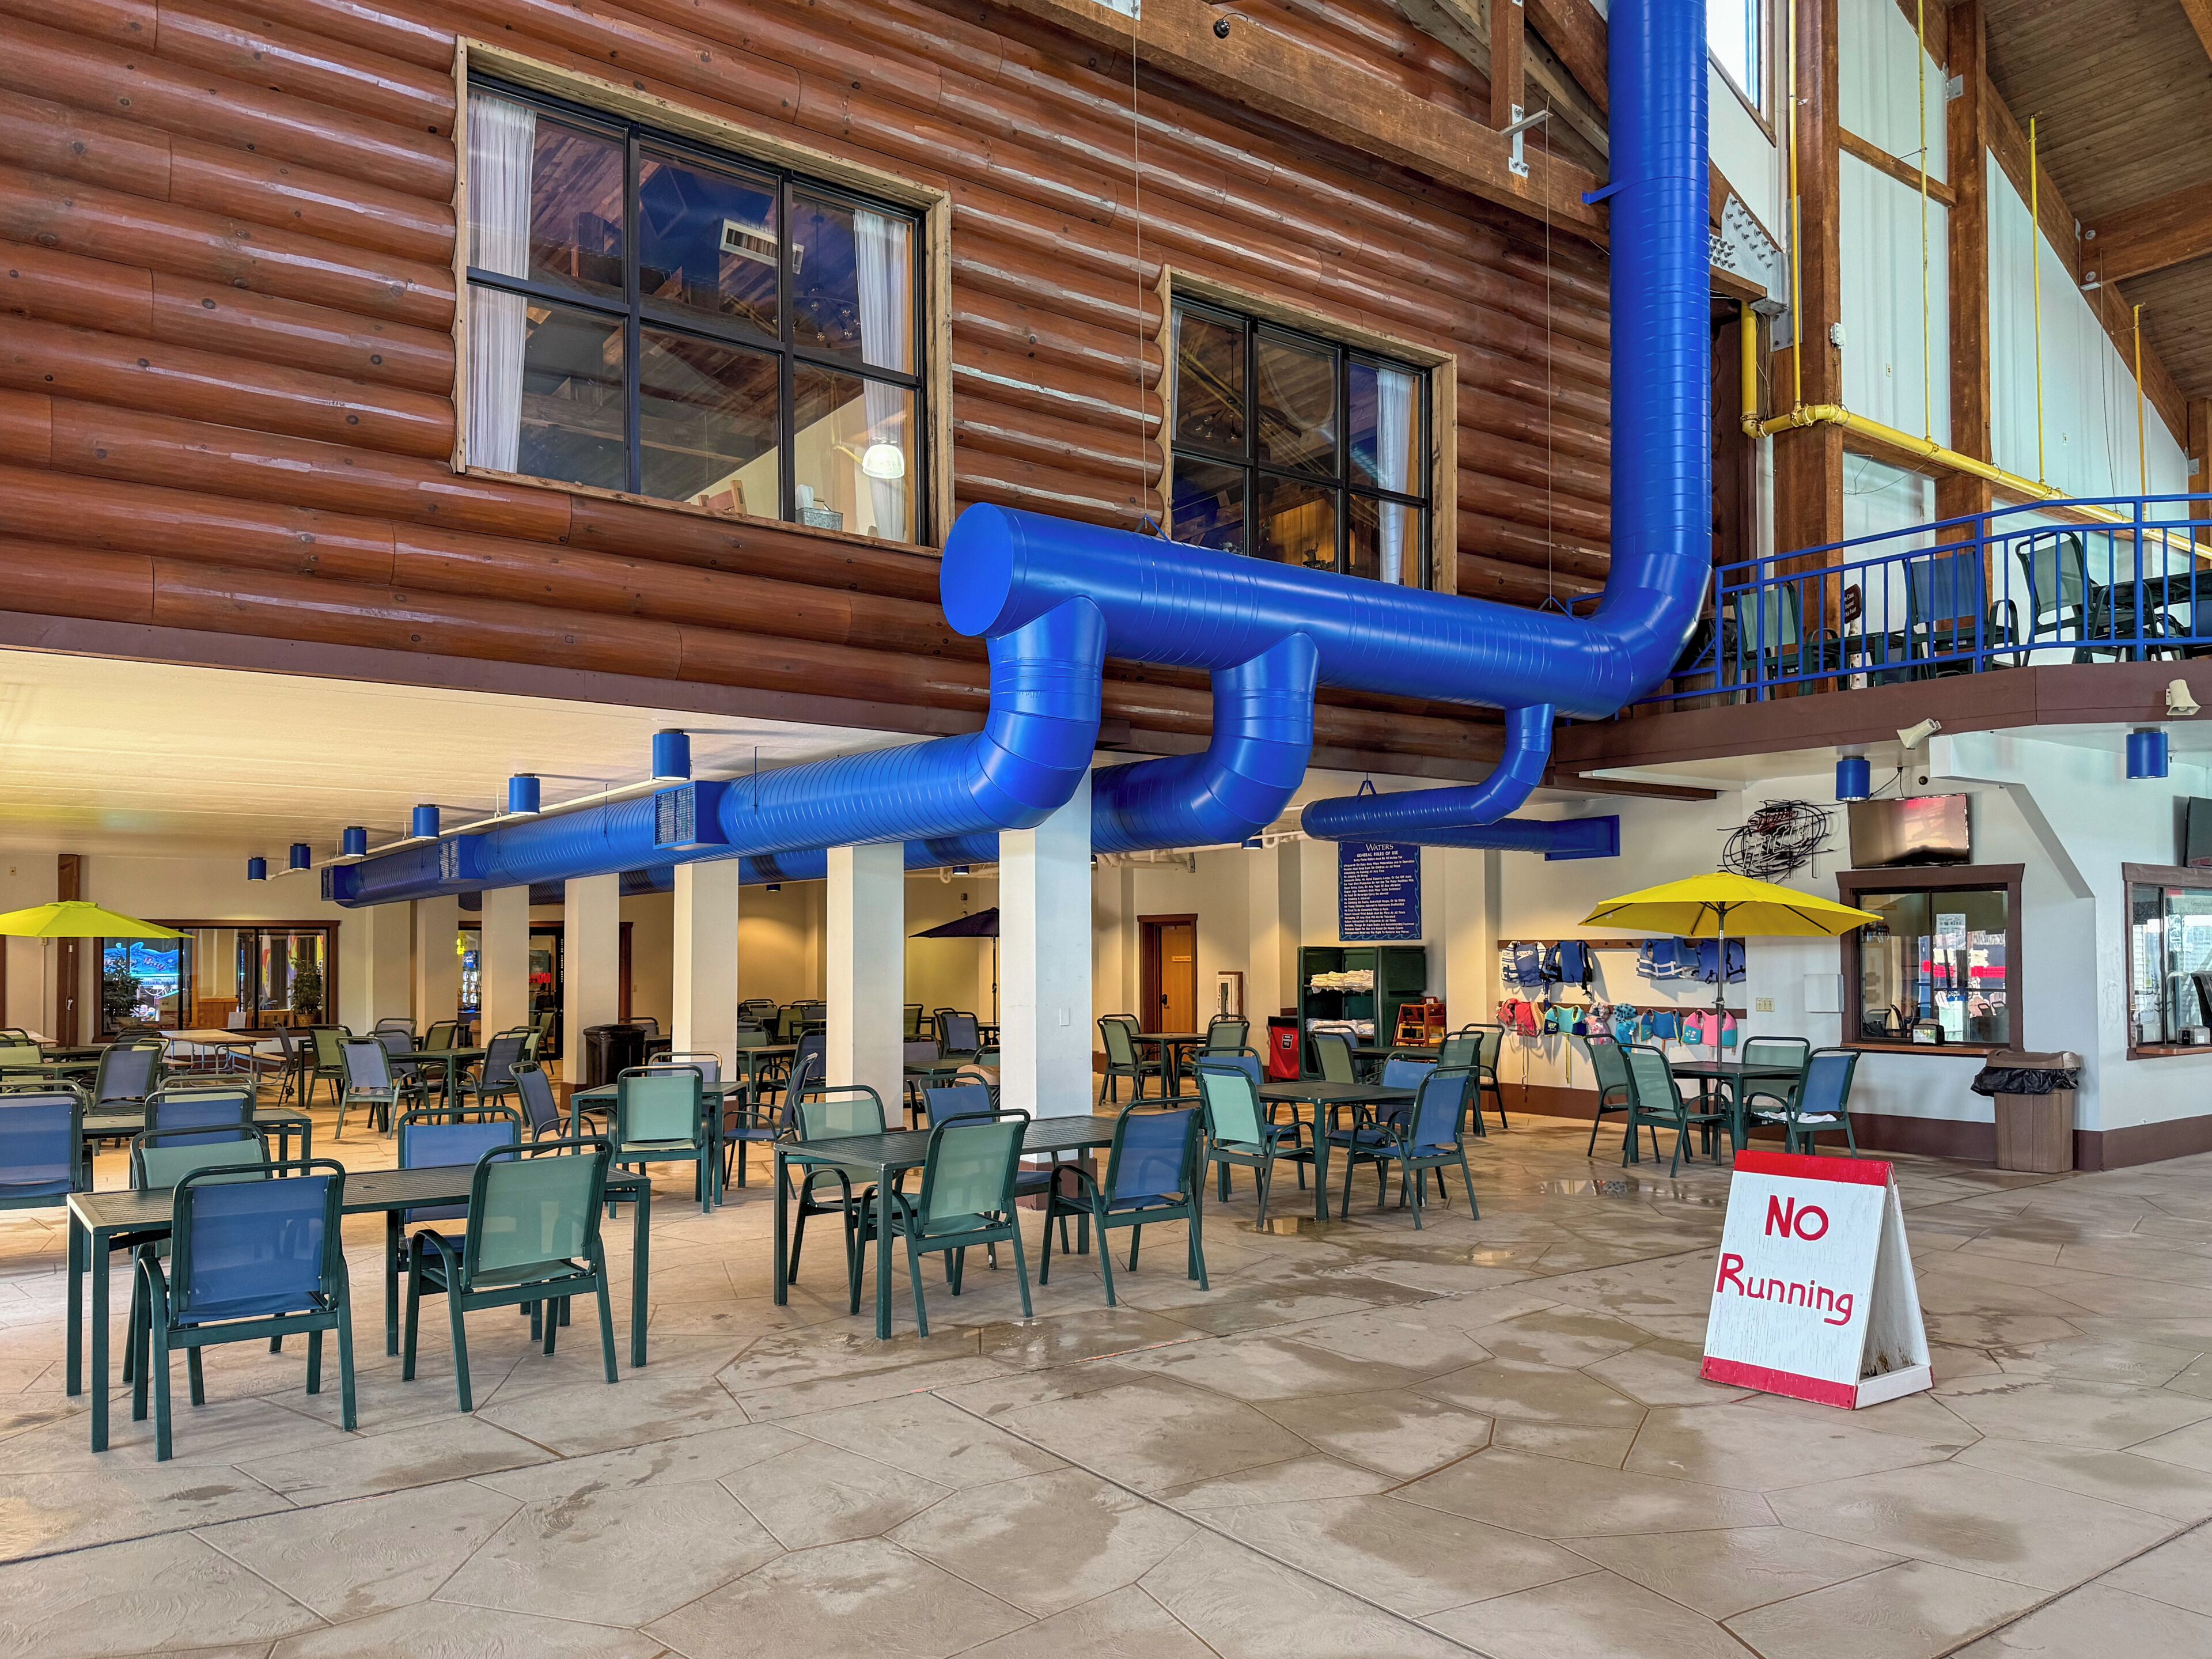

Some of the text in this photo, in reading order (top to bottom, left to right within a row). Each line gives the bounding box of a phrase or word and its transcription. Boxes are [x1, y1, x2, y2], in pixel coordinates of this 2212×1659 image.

[1365, 843, 1393, 851] WATERS
[143, 956, 166, 972] Bay
[1716, 1252, 1854, 1326] Running
